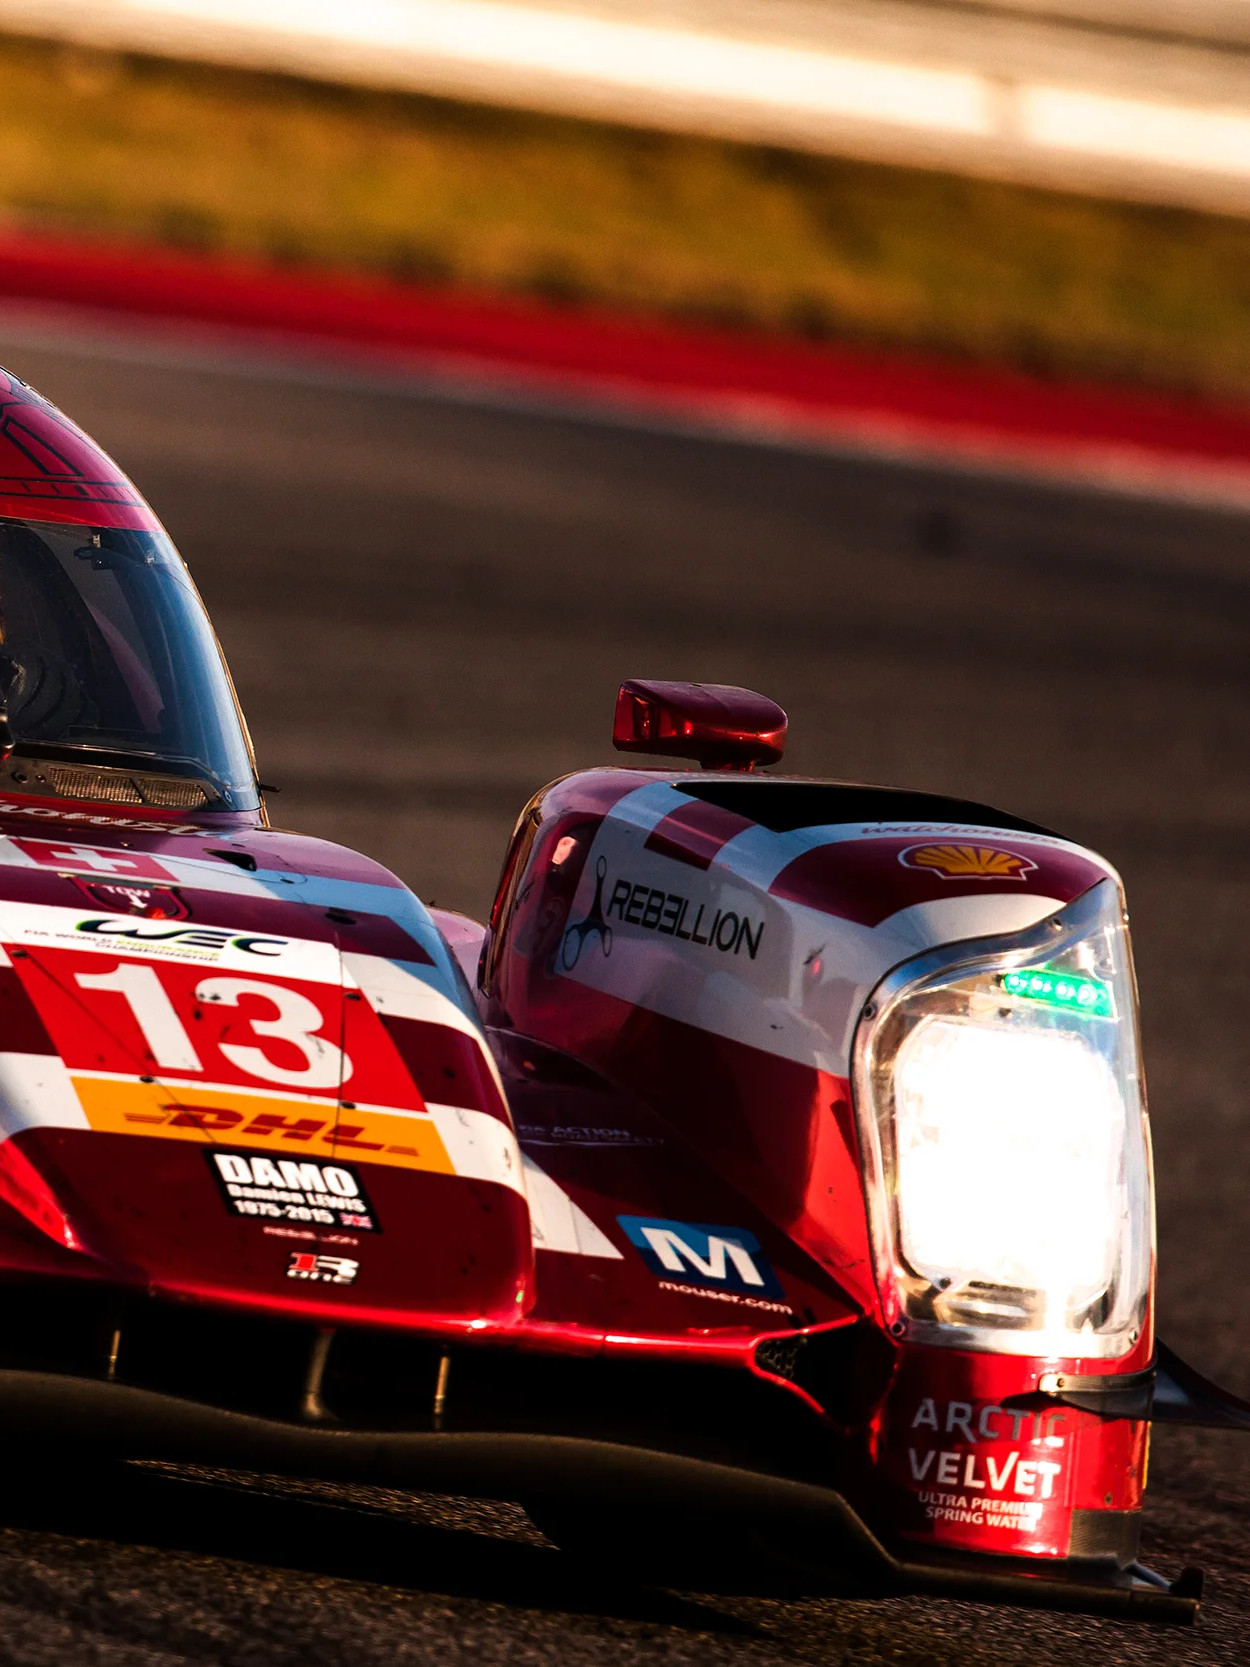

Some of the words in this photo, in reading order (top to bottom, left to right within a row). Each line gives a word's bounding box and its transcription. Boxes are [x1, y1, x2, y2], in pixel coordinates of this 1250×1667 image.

[102, 884, 151, 898] TOW
[75, 918, 290, 957] WEC
[72, 962, 354, 1091] 13
[152, 1103, 388, 1152] DHL
[213, 1153, 359, 1198] DAMO
[225, 1183, 305, 1205] Damien
[233, 1200, 335, 1225] 1975-2015
[640, 1226, 765, 1287] M
[658, 1280, 793, 1315] mouser.com
[911, 1398, 1066, 1448] ARCTIC
[908, 1447, 1061, 1499] VELVET
[918, 1491, 968, 1508] ULTRA
[971, 1497, 1044, 1519] PREMIU
[925, 1506, 984, 1525] SPRING
[986, 1513, 1037, 1532] WATE
